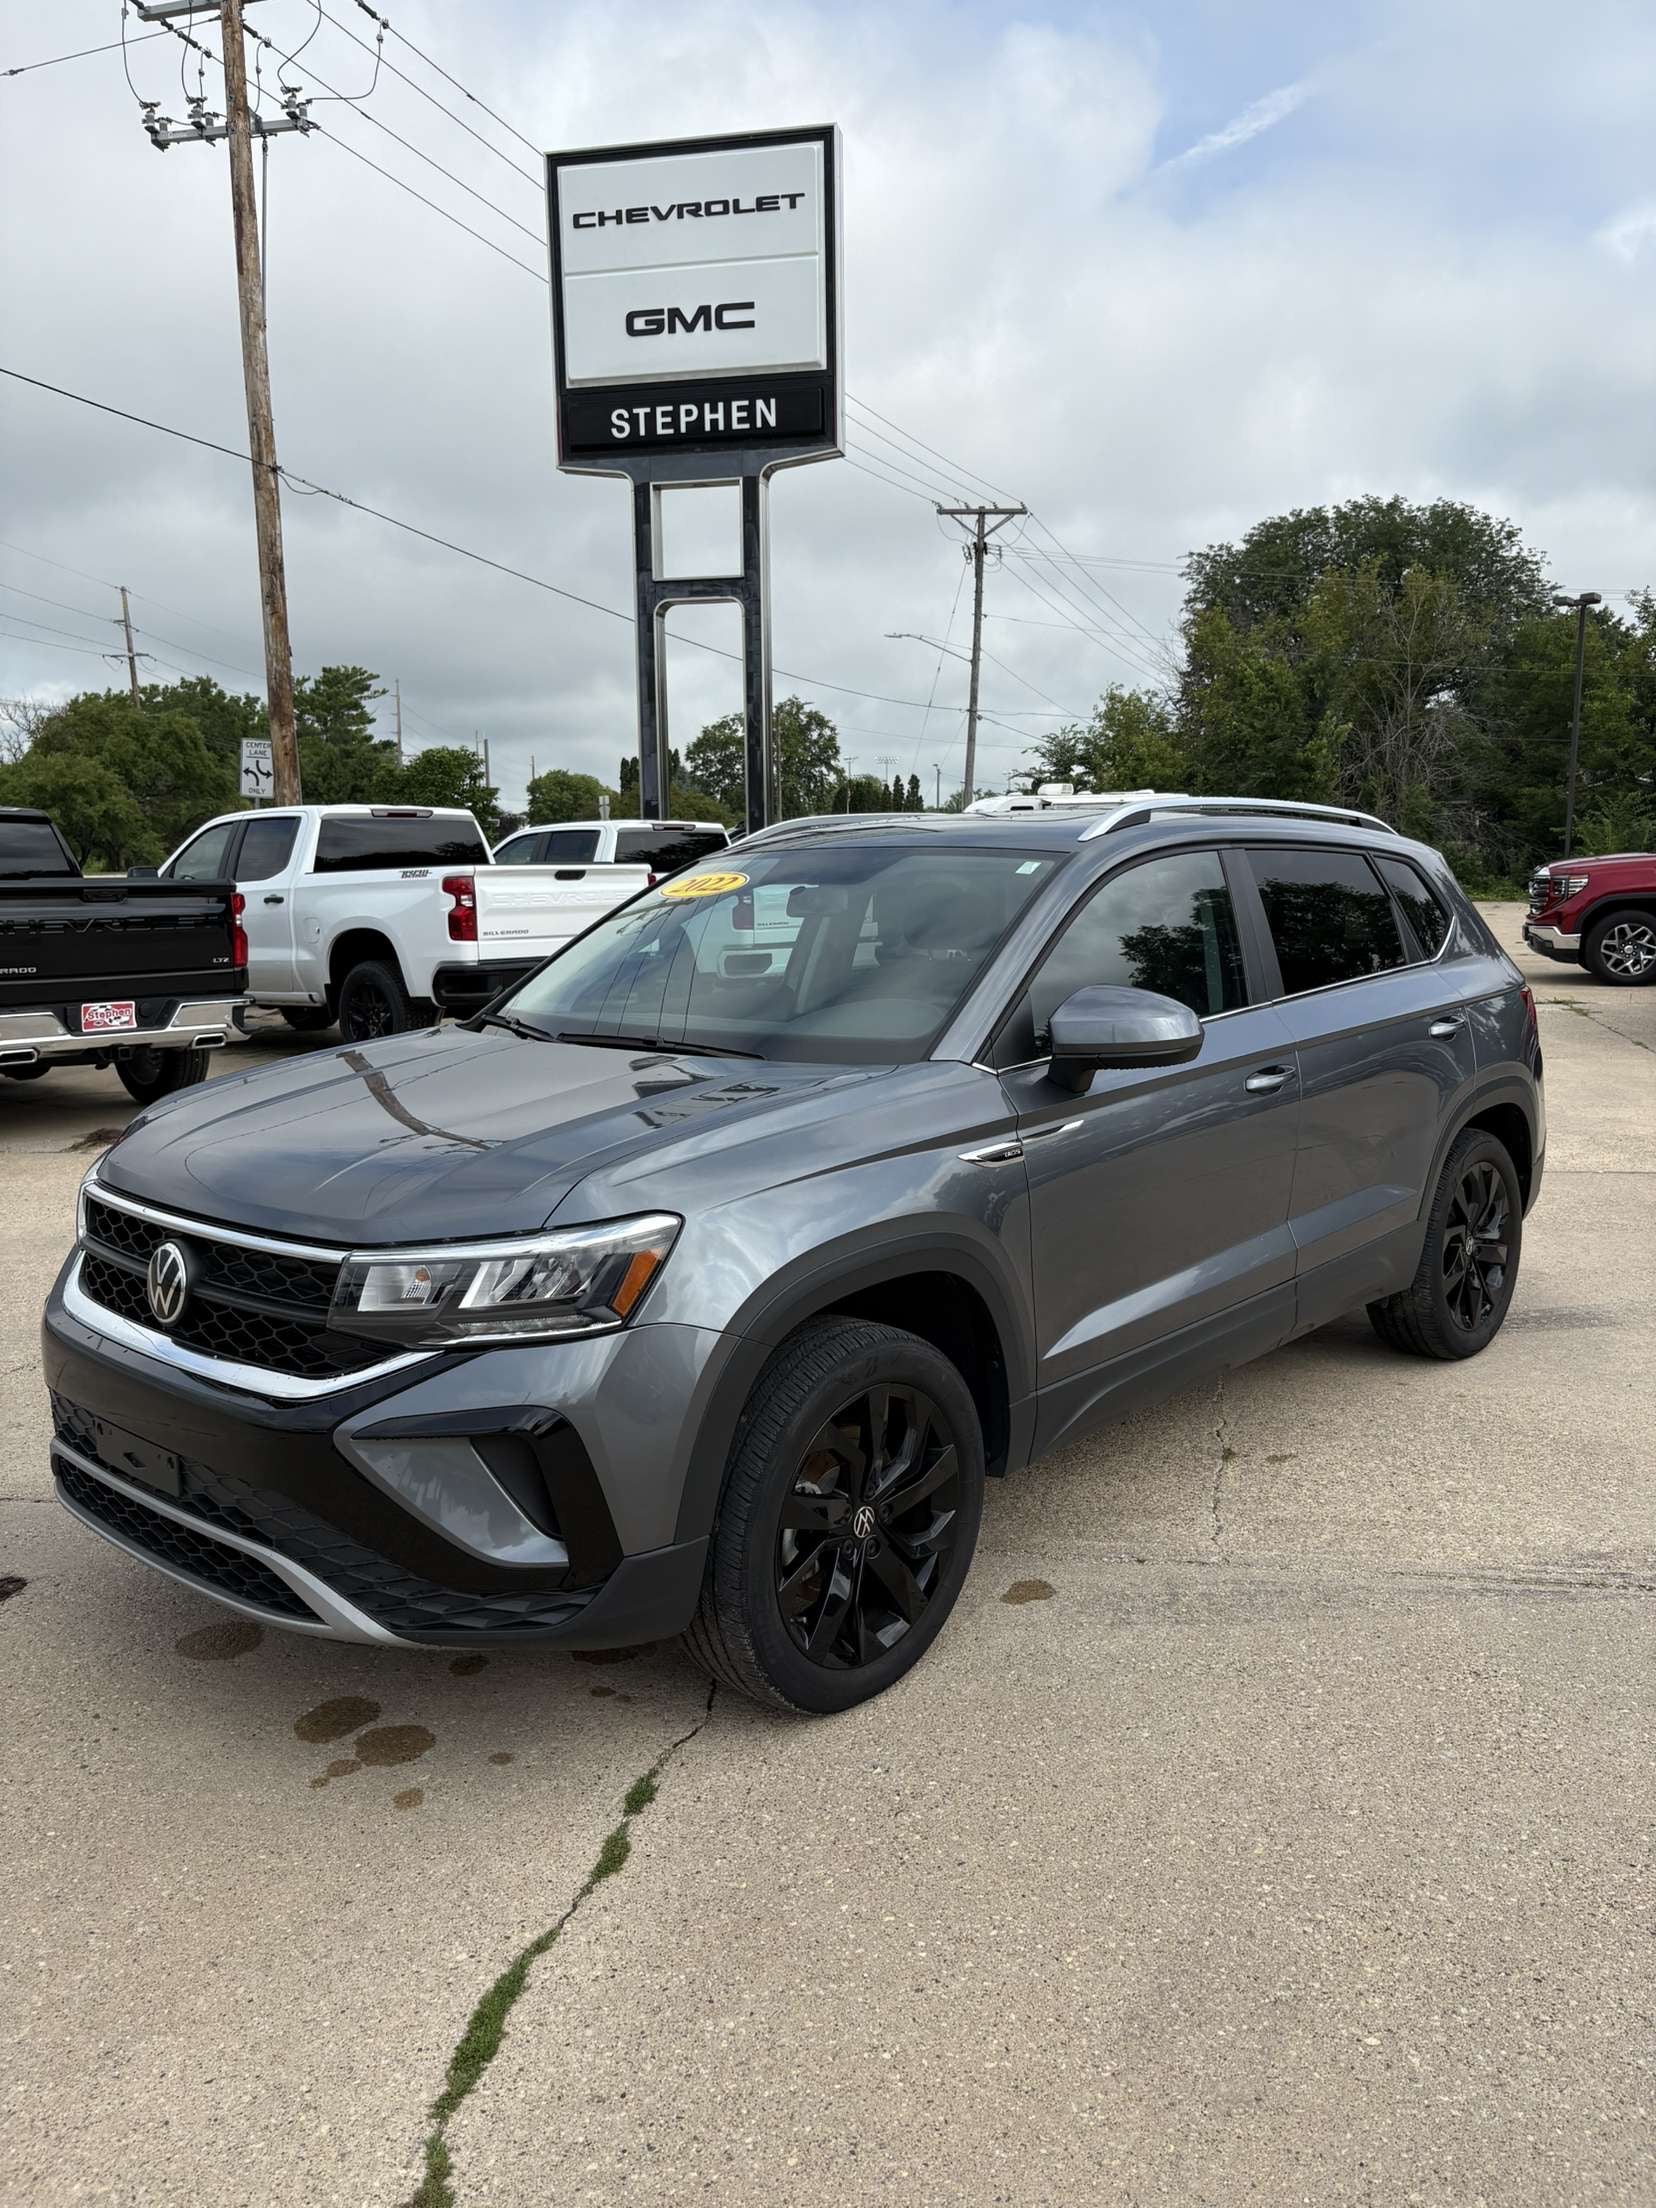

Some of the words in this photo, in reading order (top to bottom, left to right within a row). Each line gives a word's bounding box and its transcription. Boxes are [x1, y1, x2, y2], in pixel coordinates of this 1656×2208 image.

[572, 192, 806, 229] CHEVROLET
[625, 301, 756, 337] GMC
[611, 398, 778, 439] STEPHEN
[249, 749, 267, 757] LANE
[667, 876, 740, 894] 2022
[87, 1008, 132, 1021] Stephen
